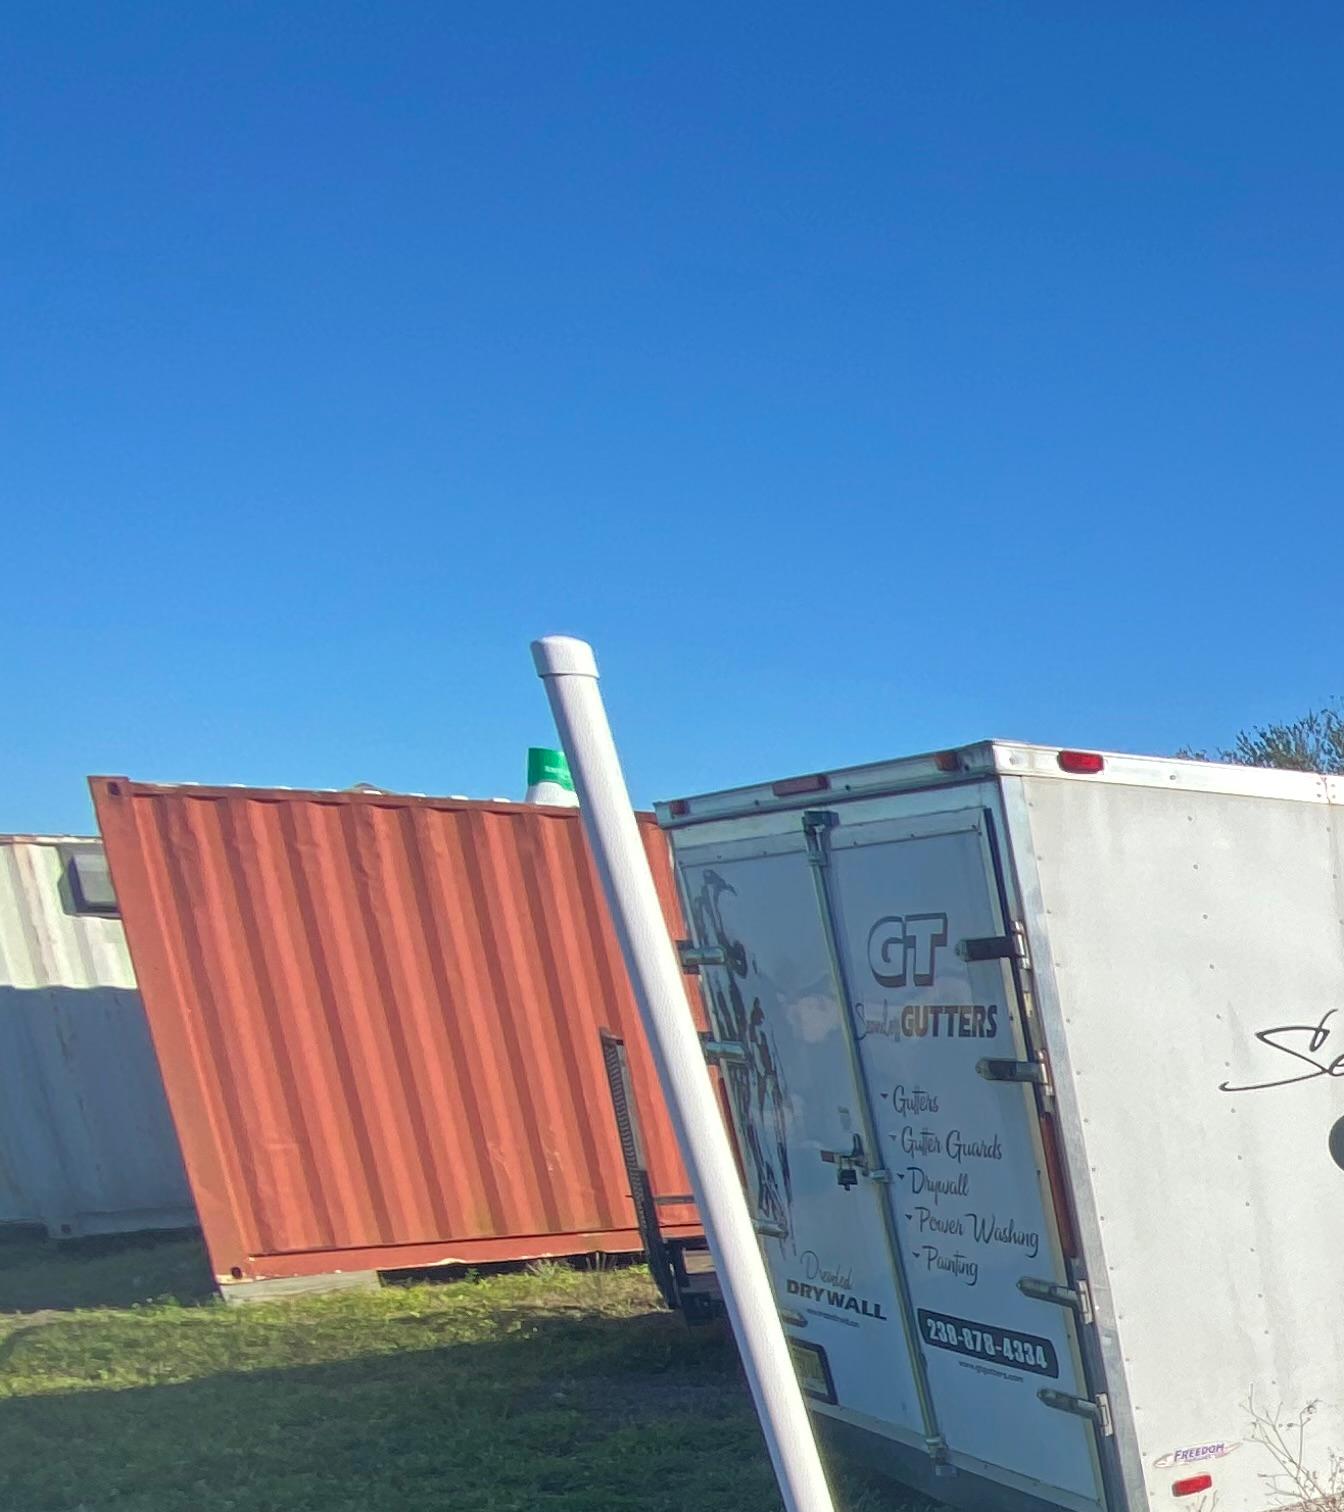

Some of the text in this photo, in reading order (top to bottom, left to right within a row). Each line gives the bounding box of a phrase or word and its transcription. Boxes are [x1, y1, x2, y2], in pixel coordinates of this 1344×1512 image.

[867, 912, 949, 988] GT
[901, 1004, 998, 1039] GUTTERS
[892, 1085, 940, 1117] Gutters
[901, 1126, 1003, 1164] Gutter Guards
[906, 1166, 970, 1206] Drywall
[914, 1206, 1040, 1259] Power Washing
[921, 1244, 979, 1287] Painting
[786, 1278, 888, 1322] DRYWALL
[1173, 1442, 1225, 1463] FREEDOM
